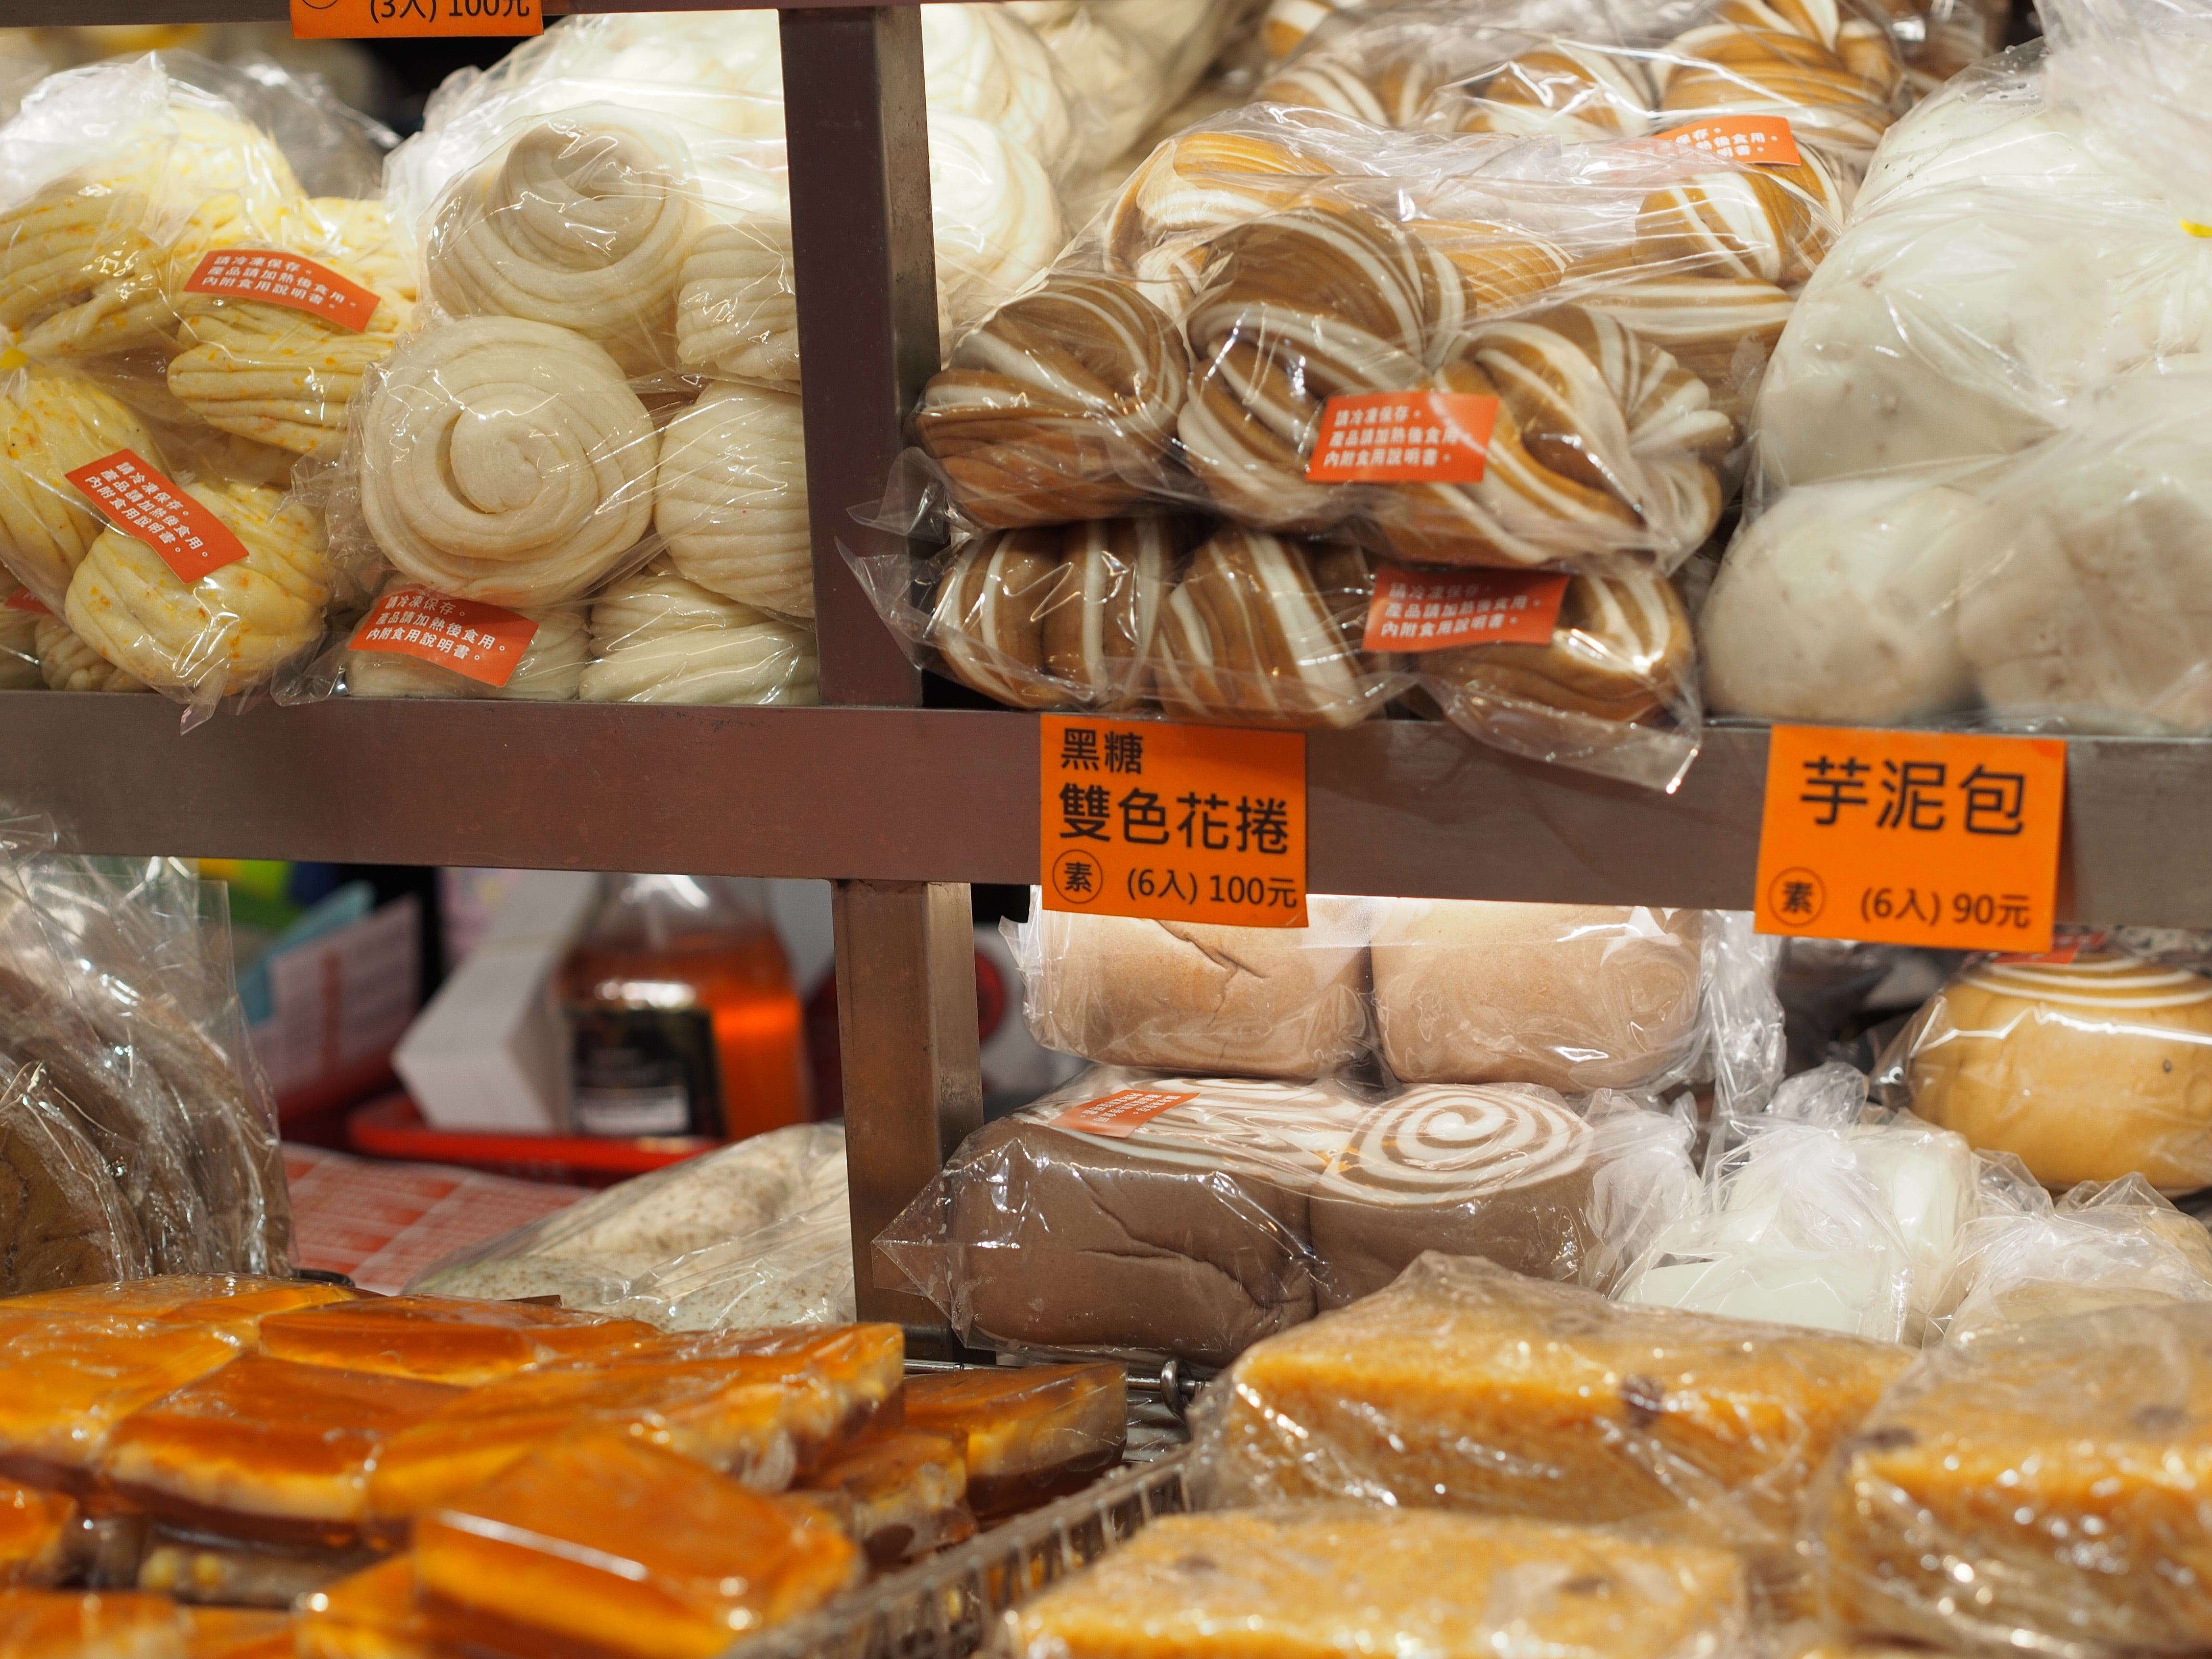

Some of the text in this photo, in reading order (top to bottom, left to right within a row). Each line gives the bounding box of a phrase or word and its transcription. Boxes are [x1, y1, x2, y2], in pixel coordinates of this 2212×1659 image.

[371, 0, 530, 23] (3入) 100元
[214, 255, 312, 275] 請冷凍保存。
[202, 276, 335, 309] 內附食用說明書。
[208, 265, 356, 307] 產品請加熱後食用。
[1334, 405, 1421, 427] 請冷凍保存。
[116, 462, 189, 516] 請冷凍保存。
[85, 476, 181, 553] 內附食用說明書。
[99, 469, 208, 557] 產品請加熱後食用。
[383, 592, 466, 616] 請冷凍保存。
[366, 627, 481, 661] 內附食用說明書。
[376, 611, 506, 651] 產品請加熱後食用。
[1061, 728, 1143, 775] 黑糖
[1800, 756, 2025, 835] 芋泥包
[1059, 783, 1289, 854] 雙色花捲
[1064, 862, 1092, 892] 素
[1128, 868, 1297, 908] (6入) 100元
[1781, 881, 1814, 914] 素
[1861, 886, 2031, 928] (6入) 90元
